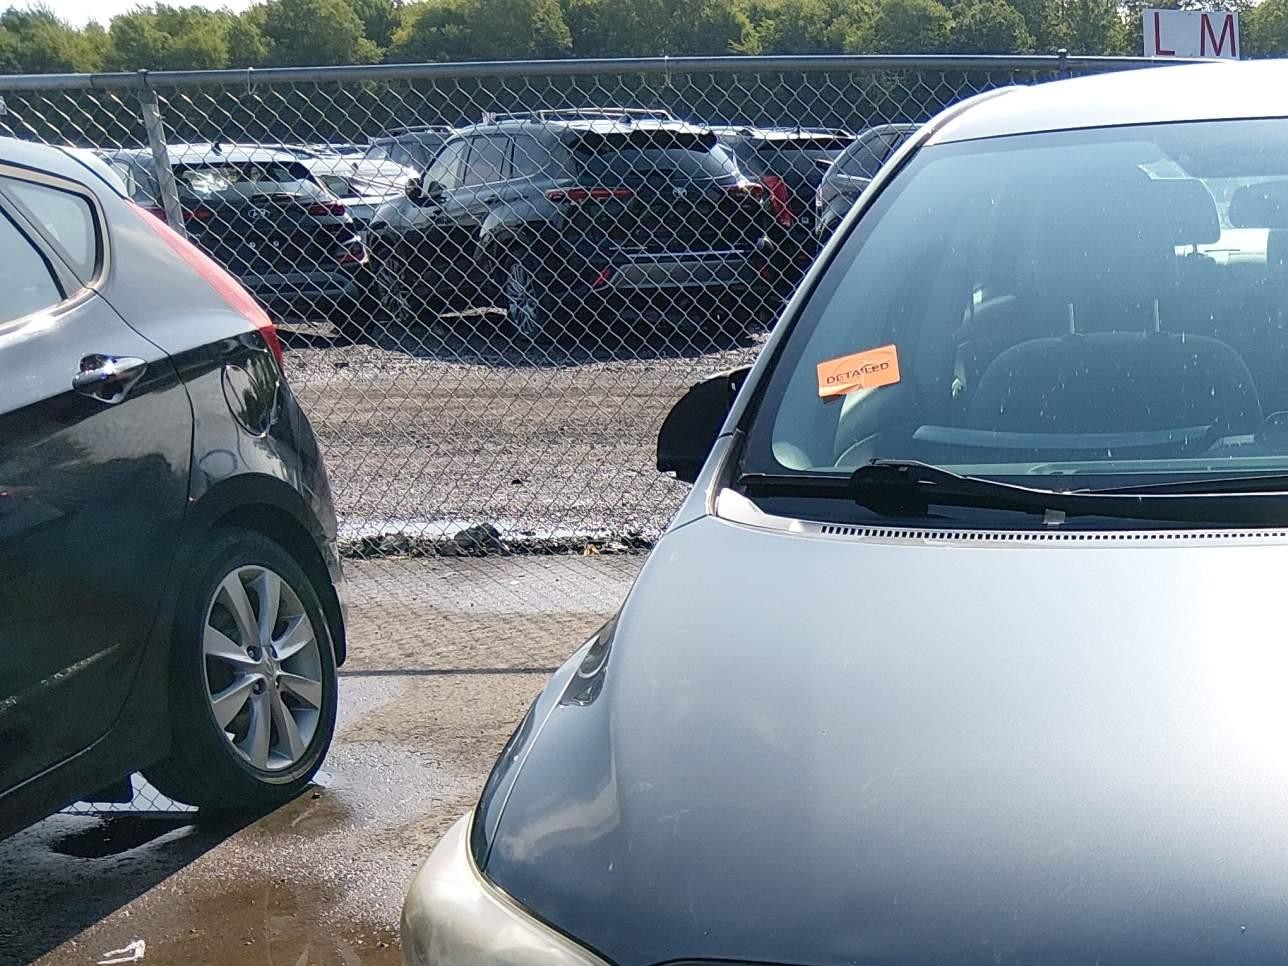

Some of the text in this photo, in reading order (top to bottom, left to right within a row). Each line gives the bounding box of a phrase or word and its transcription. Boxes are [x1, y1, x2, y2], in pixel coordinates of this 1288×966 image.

[1154, 11, 1237, 57] L M
[826, 362, 889, 384] DETAILED
